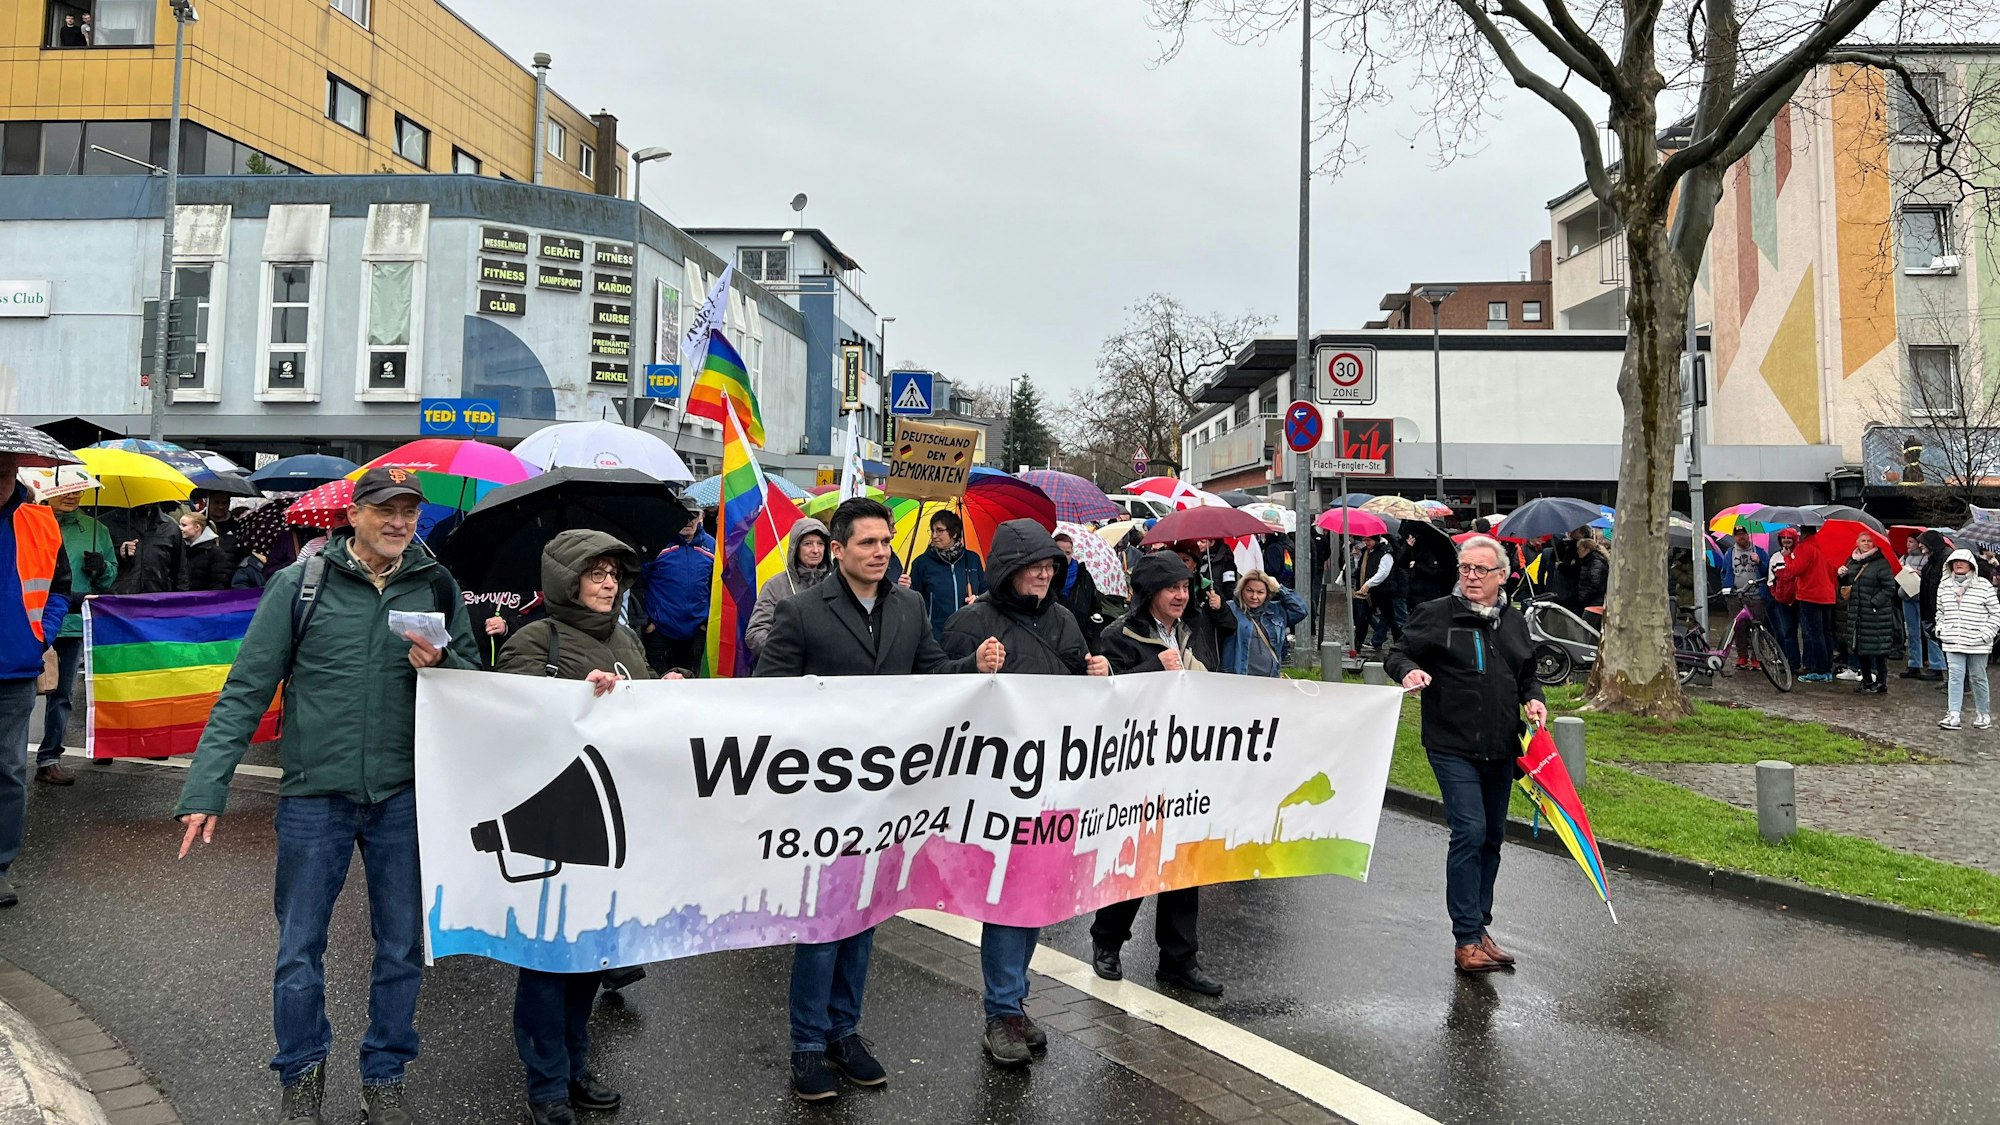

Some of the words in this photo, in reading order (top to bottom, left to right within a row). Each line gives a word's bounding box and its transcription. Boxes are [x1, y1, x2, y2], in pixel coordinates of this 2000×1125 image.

[484, 238, 527, 252] WESSELINGER
[544, 245, 580, 259] GERÄTE
[597, 251, 633, 265] FITNESS
[483, 267, 525, 281] FITNESS
[540, 274, 582, 288] KAMPFSPORT
[597, 281, 632, 294] KARDIO
[13, 292, 44, 304] Club
[489, 300, 516, 312] CLUB
[599, 312, 630, 324] KURSE
[593, 338, 630, 349] FREIHANTE
[599, 346, 627, 355] BEREICH
[595, 370, 628, 382] ZIRKEL
[848, 357, 856, 396] FITNESS
[1336, 362, 1356, 378] 30
[648, 374, 678, 387] TEDi
[1332, 388, 1360, 397] ZONE
[424, 409, 456, 422] TEDi
[463, 410, 496, 424] TEDi
[901, 430, 970, 448] DEUTSCHLAND
[926, 450, 947, 461] DEN
[890, 460, 965, 484] DEMOKRATEN
[1313, 460, 1382, 471] Flach-Fengler-Str.
[689, 721, 1046, 799] Wesseling
[1059, 714, 1157, 782] bleibt
[1165, 714, 1280, 764] bunt!
[757, 805, 950, 860] 18.02.2024
[982, 810, 1075, 846] DEMO
[1079, 808, 1104, 839] für
[1106, 789, 1211, 832] Demokratie
